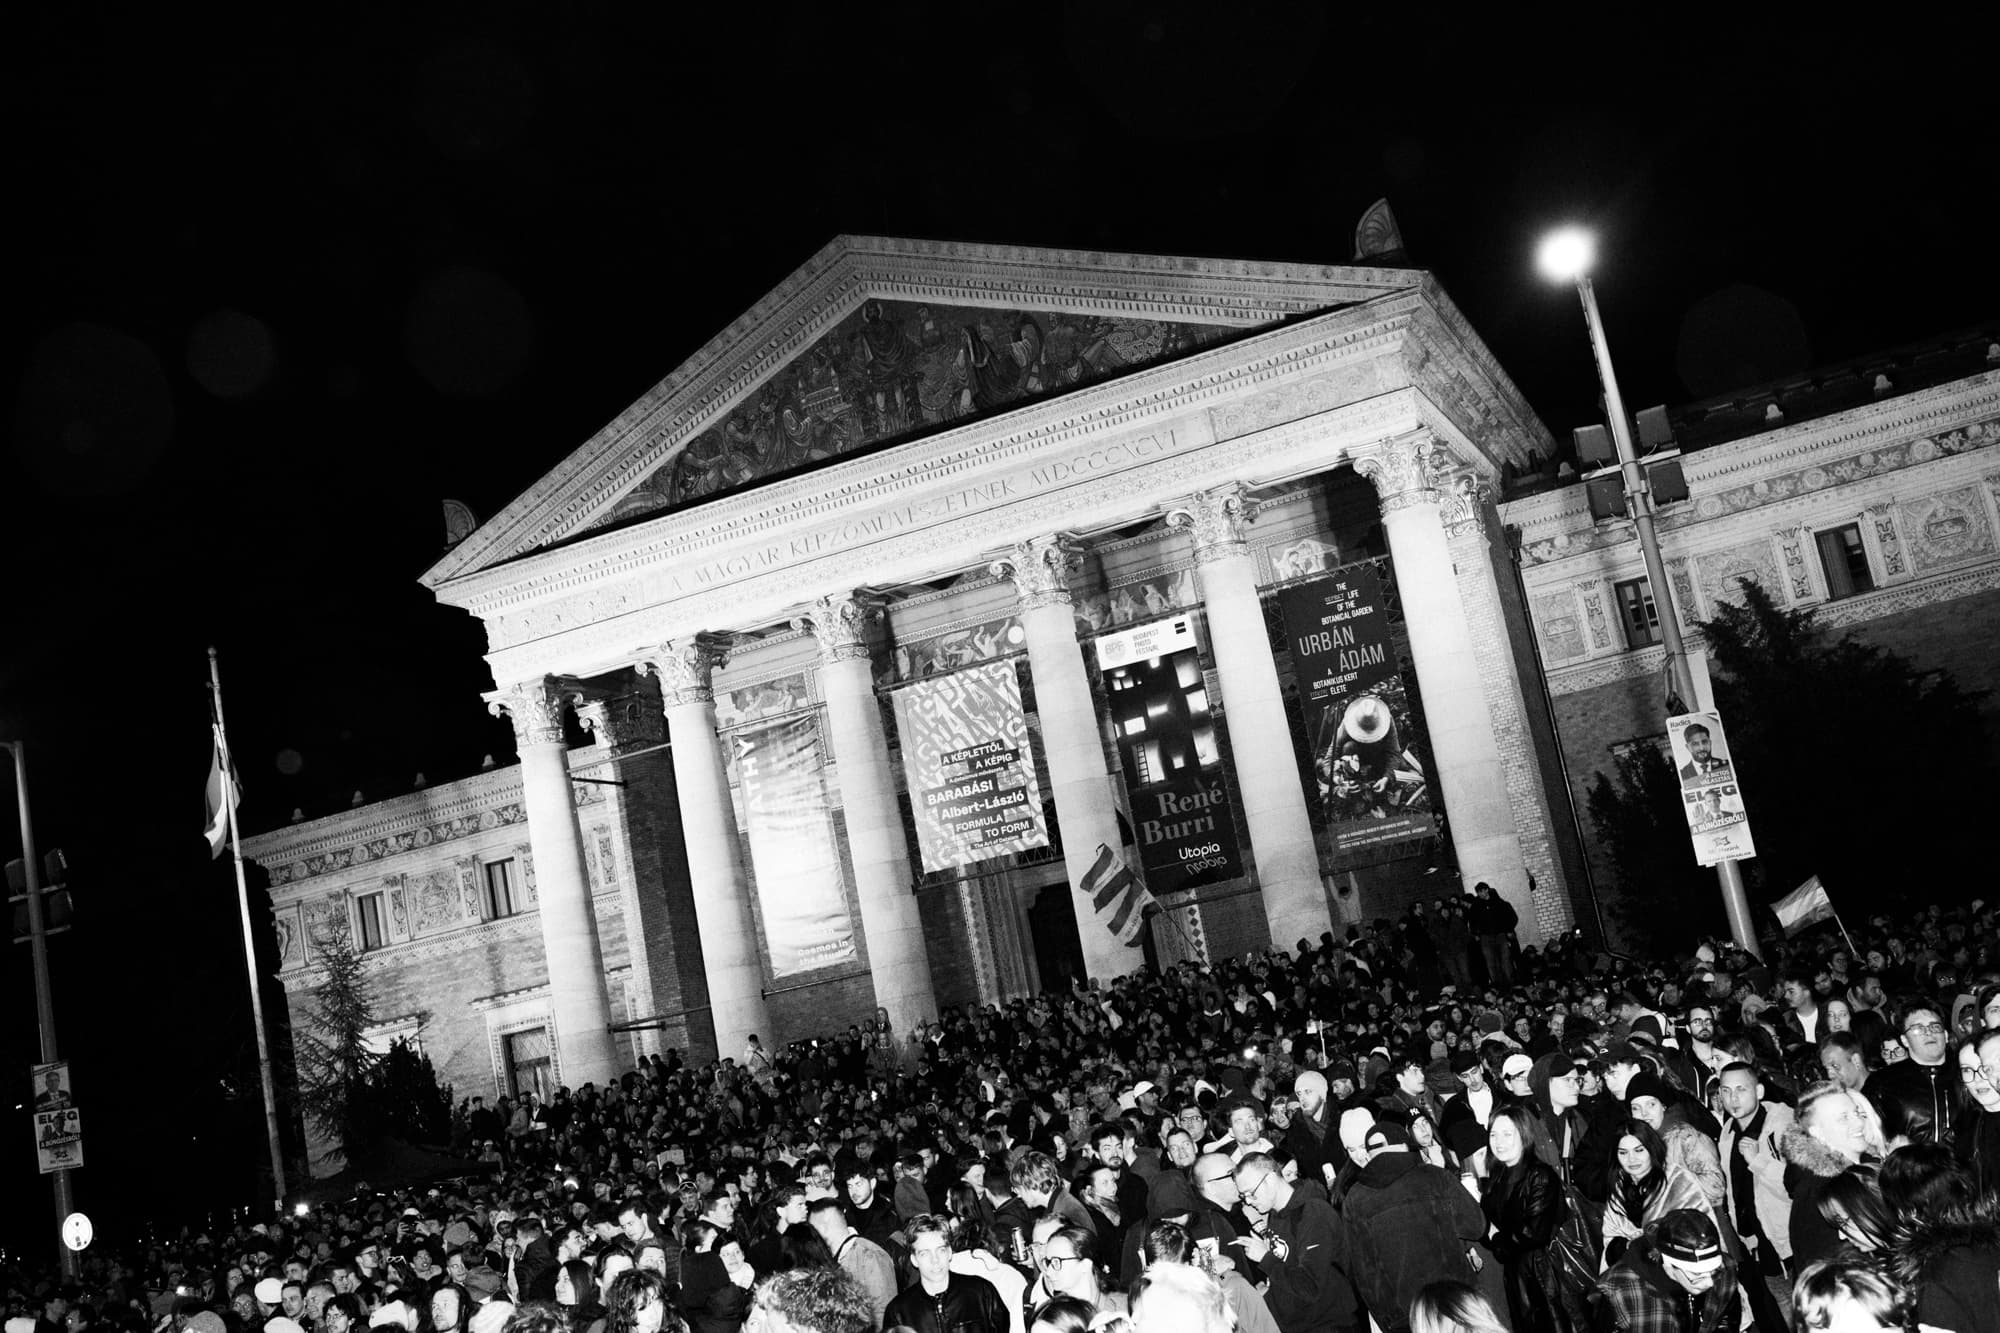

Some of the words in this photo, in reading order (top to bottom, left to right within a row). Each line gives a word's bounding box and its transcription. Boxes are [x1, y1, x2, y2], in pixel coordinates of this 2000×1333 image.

[694, 546, 779, 585] MAGYAR
[1336, 582, 1347, 591] THE
[1347, 589, 1360, 599] LIFE
[1321, 611, 1352, 625] BOTANICAL
[1351, 605, 1374, 617] GARDEN
[1299, 625, 1355, 656] URBÁN
[1340, 643, 1385, 672] ÁDÁM
[1313, 675, 1343, 689] BOTANIKUS
[1343, 672, 1358, 682] KERT
[943, 756, 950, 765] A
[950, 742, 1004, 761] KÉPLETTŐL
[975, 760, 983, 769] A
[984, 753, 1013, 767] KÉPIG
[927, 779, 994, 806] BARABÁSI
[1156, 781, 1224, 817] René
[942, 790, 1025, 820] Albert-László
[956, 814, 1004, 832] FORMULA
[985, 828, 999, 838] TO
[1001, 821, 1030, 835] FORM
[1141, 808, 1215, 846] Burri
[1178, 842, 1221, 860] Utopia
